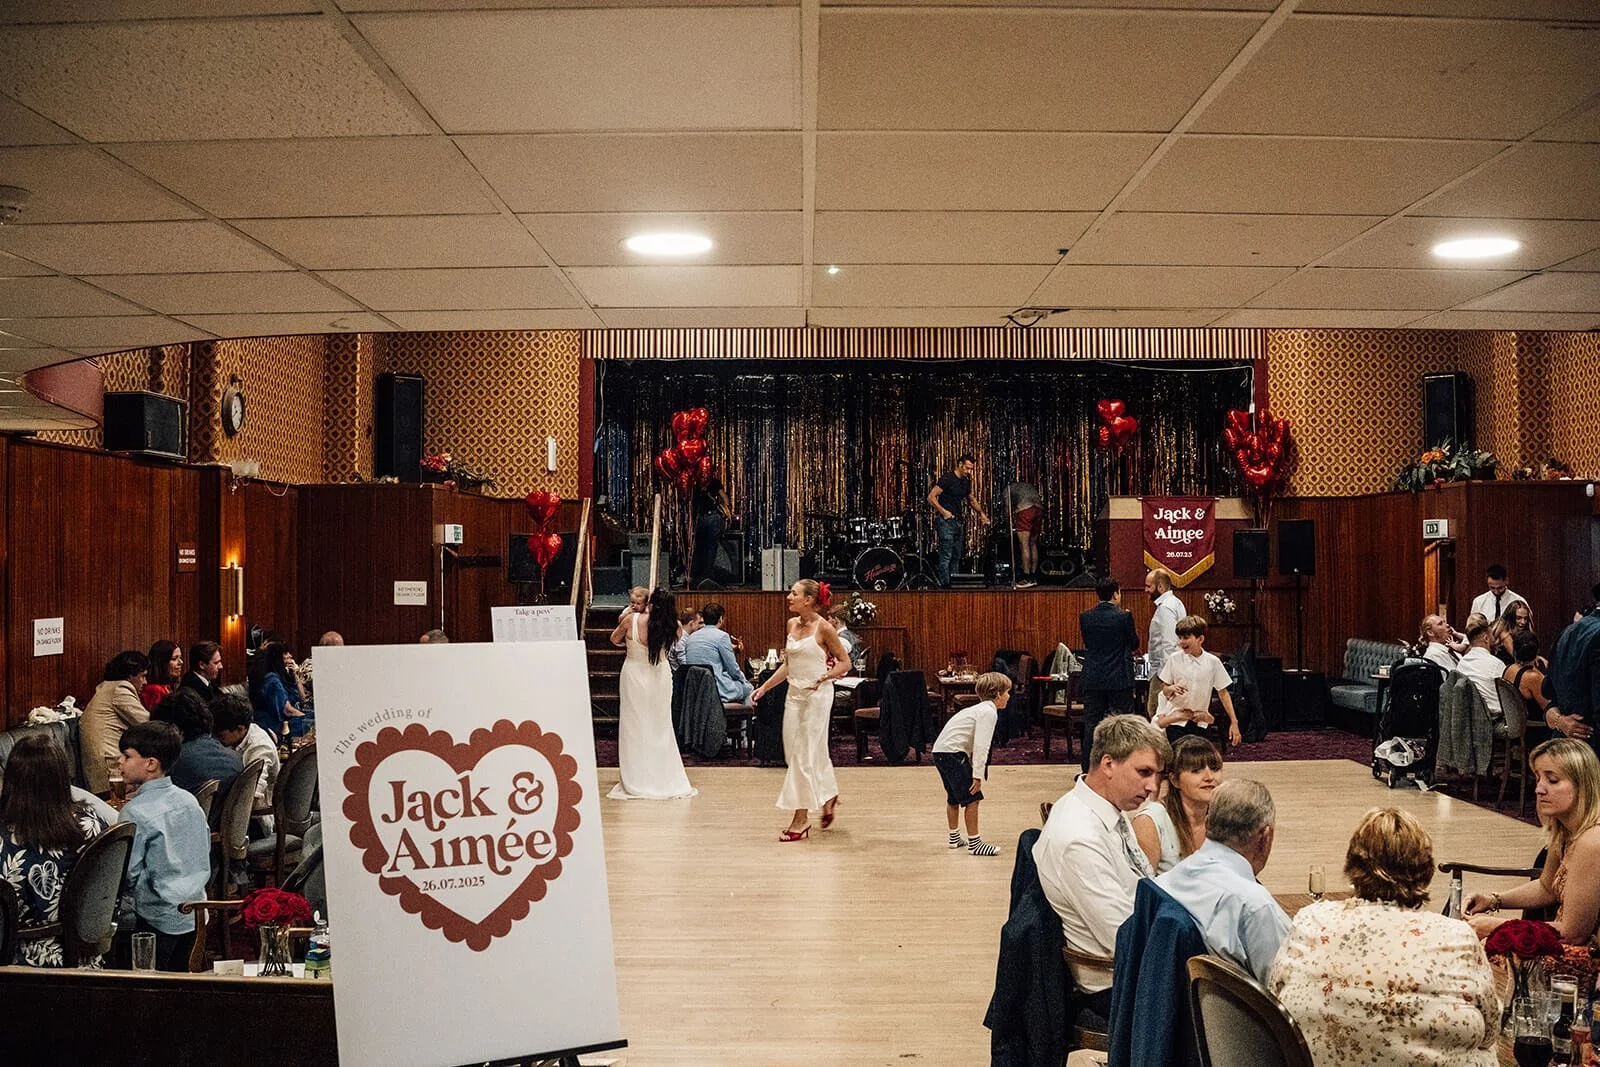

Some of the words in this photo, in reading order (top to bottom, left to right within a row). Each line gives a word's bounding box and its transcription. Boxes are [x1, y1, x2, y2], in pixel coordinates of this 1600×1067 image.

[1153, 507, 1192, 524] Jack
[1194, 507, 1206, 520] &
[1154, 525, 1204, 544] Aimee
[333, 732, 357, 755] The
[356, 707, 414, 733] wedding
[417, 707, 433, 719] of
[381, 775, 497, 833] Jack
[507, 771, 545, 816] &
[421, 875, 486, 892] 26.07.2025
